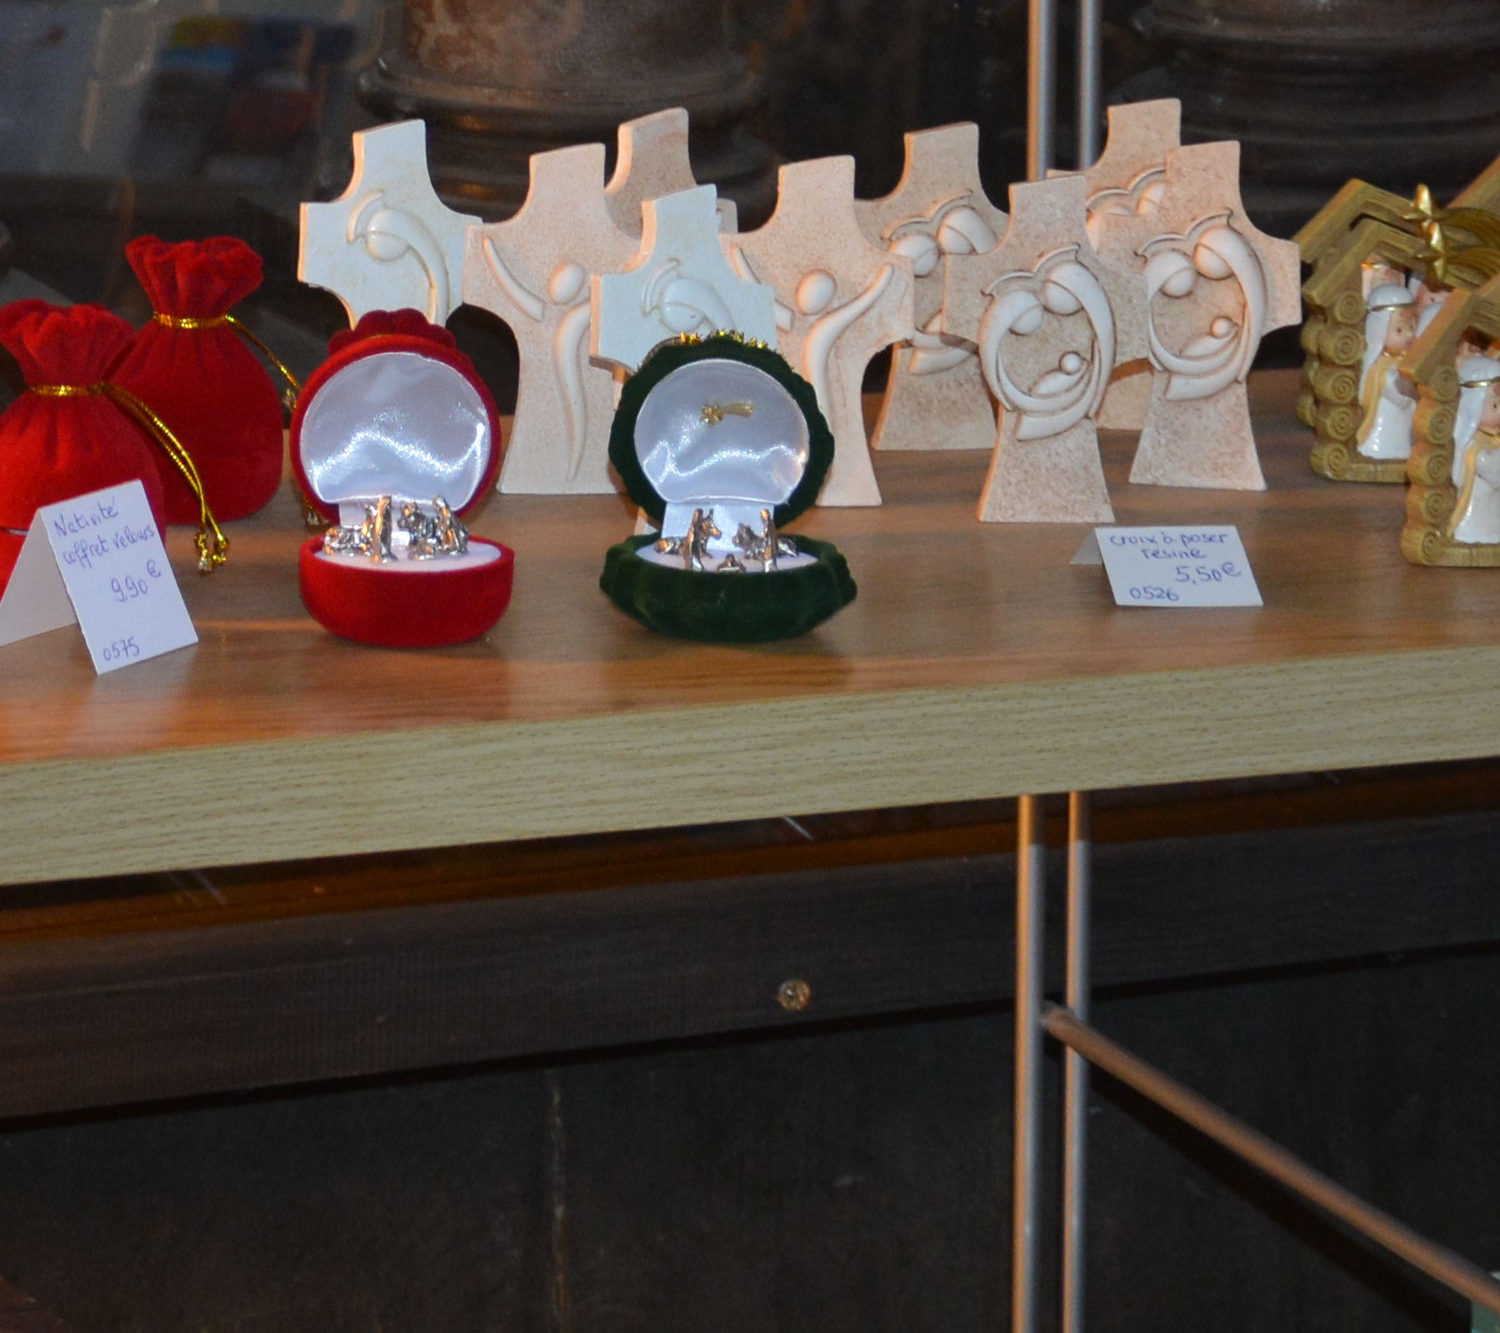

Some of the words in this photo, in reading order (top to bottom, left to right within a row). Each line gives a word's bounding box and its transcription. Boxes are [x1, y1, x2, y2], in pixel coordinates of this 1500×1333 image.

[53, 497, 119, 537] Nativité
[1110, 535, 1158, 547] croix
[1163, 531, 1177, 544] à
[1180, 532, 1229, 547] poser
[62, 535, 111, 569] coffret
[1129, 586, 1180, 602] 0526
[102, 636, 141, 661] 0575
